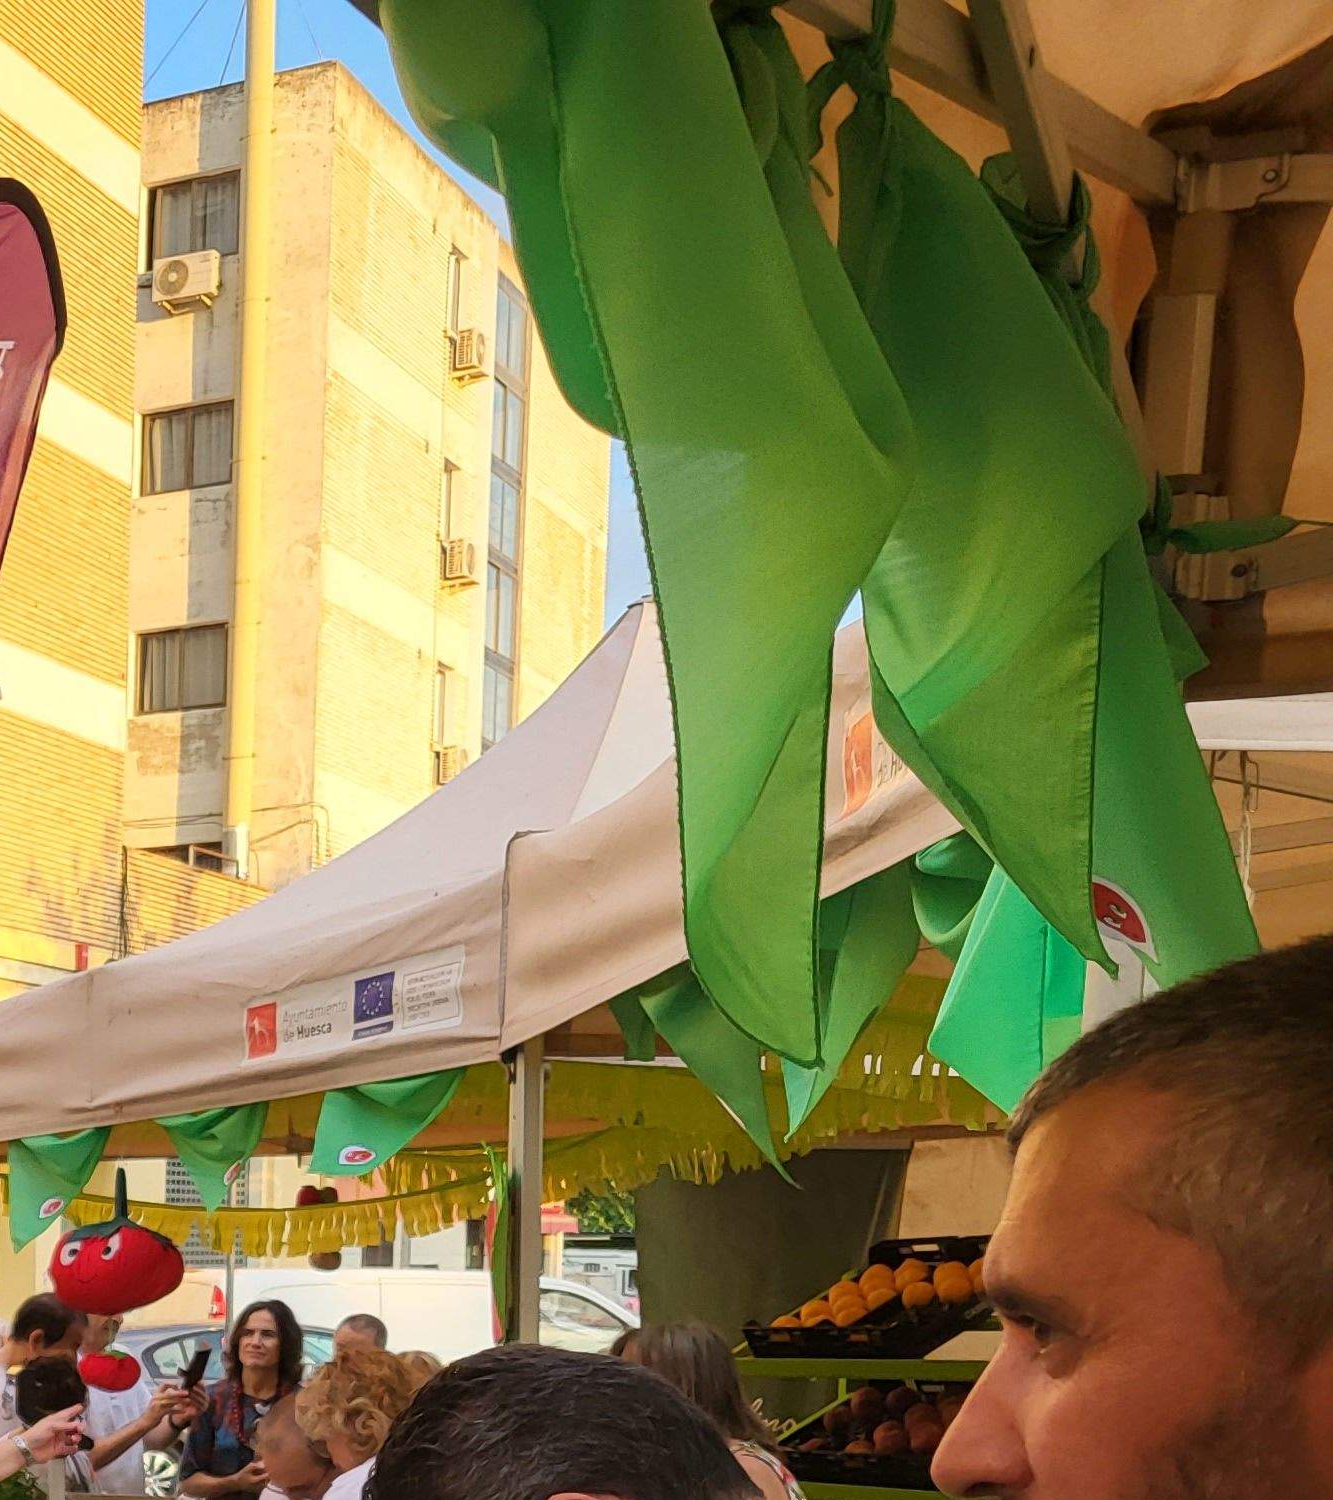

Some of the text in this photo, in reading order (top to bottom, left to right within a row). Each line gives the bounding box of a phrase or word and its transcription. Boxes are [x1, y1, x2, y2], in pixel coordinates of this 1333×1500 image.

[282, 1000, 349, 1025] Ayuntamiento
[283, 1023, 332, 1042] de Huesca
